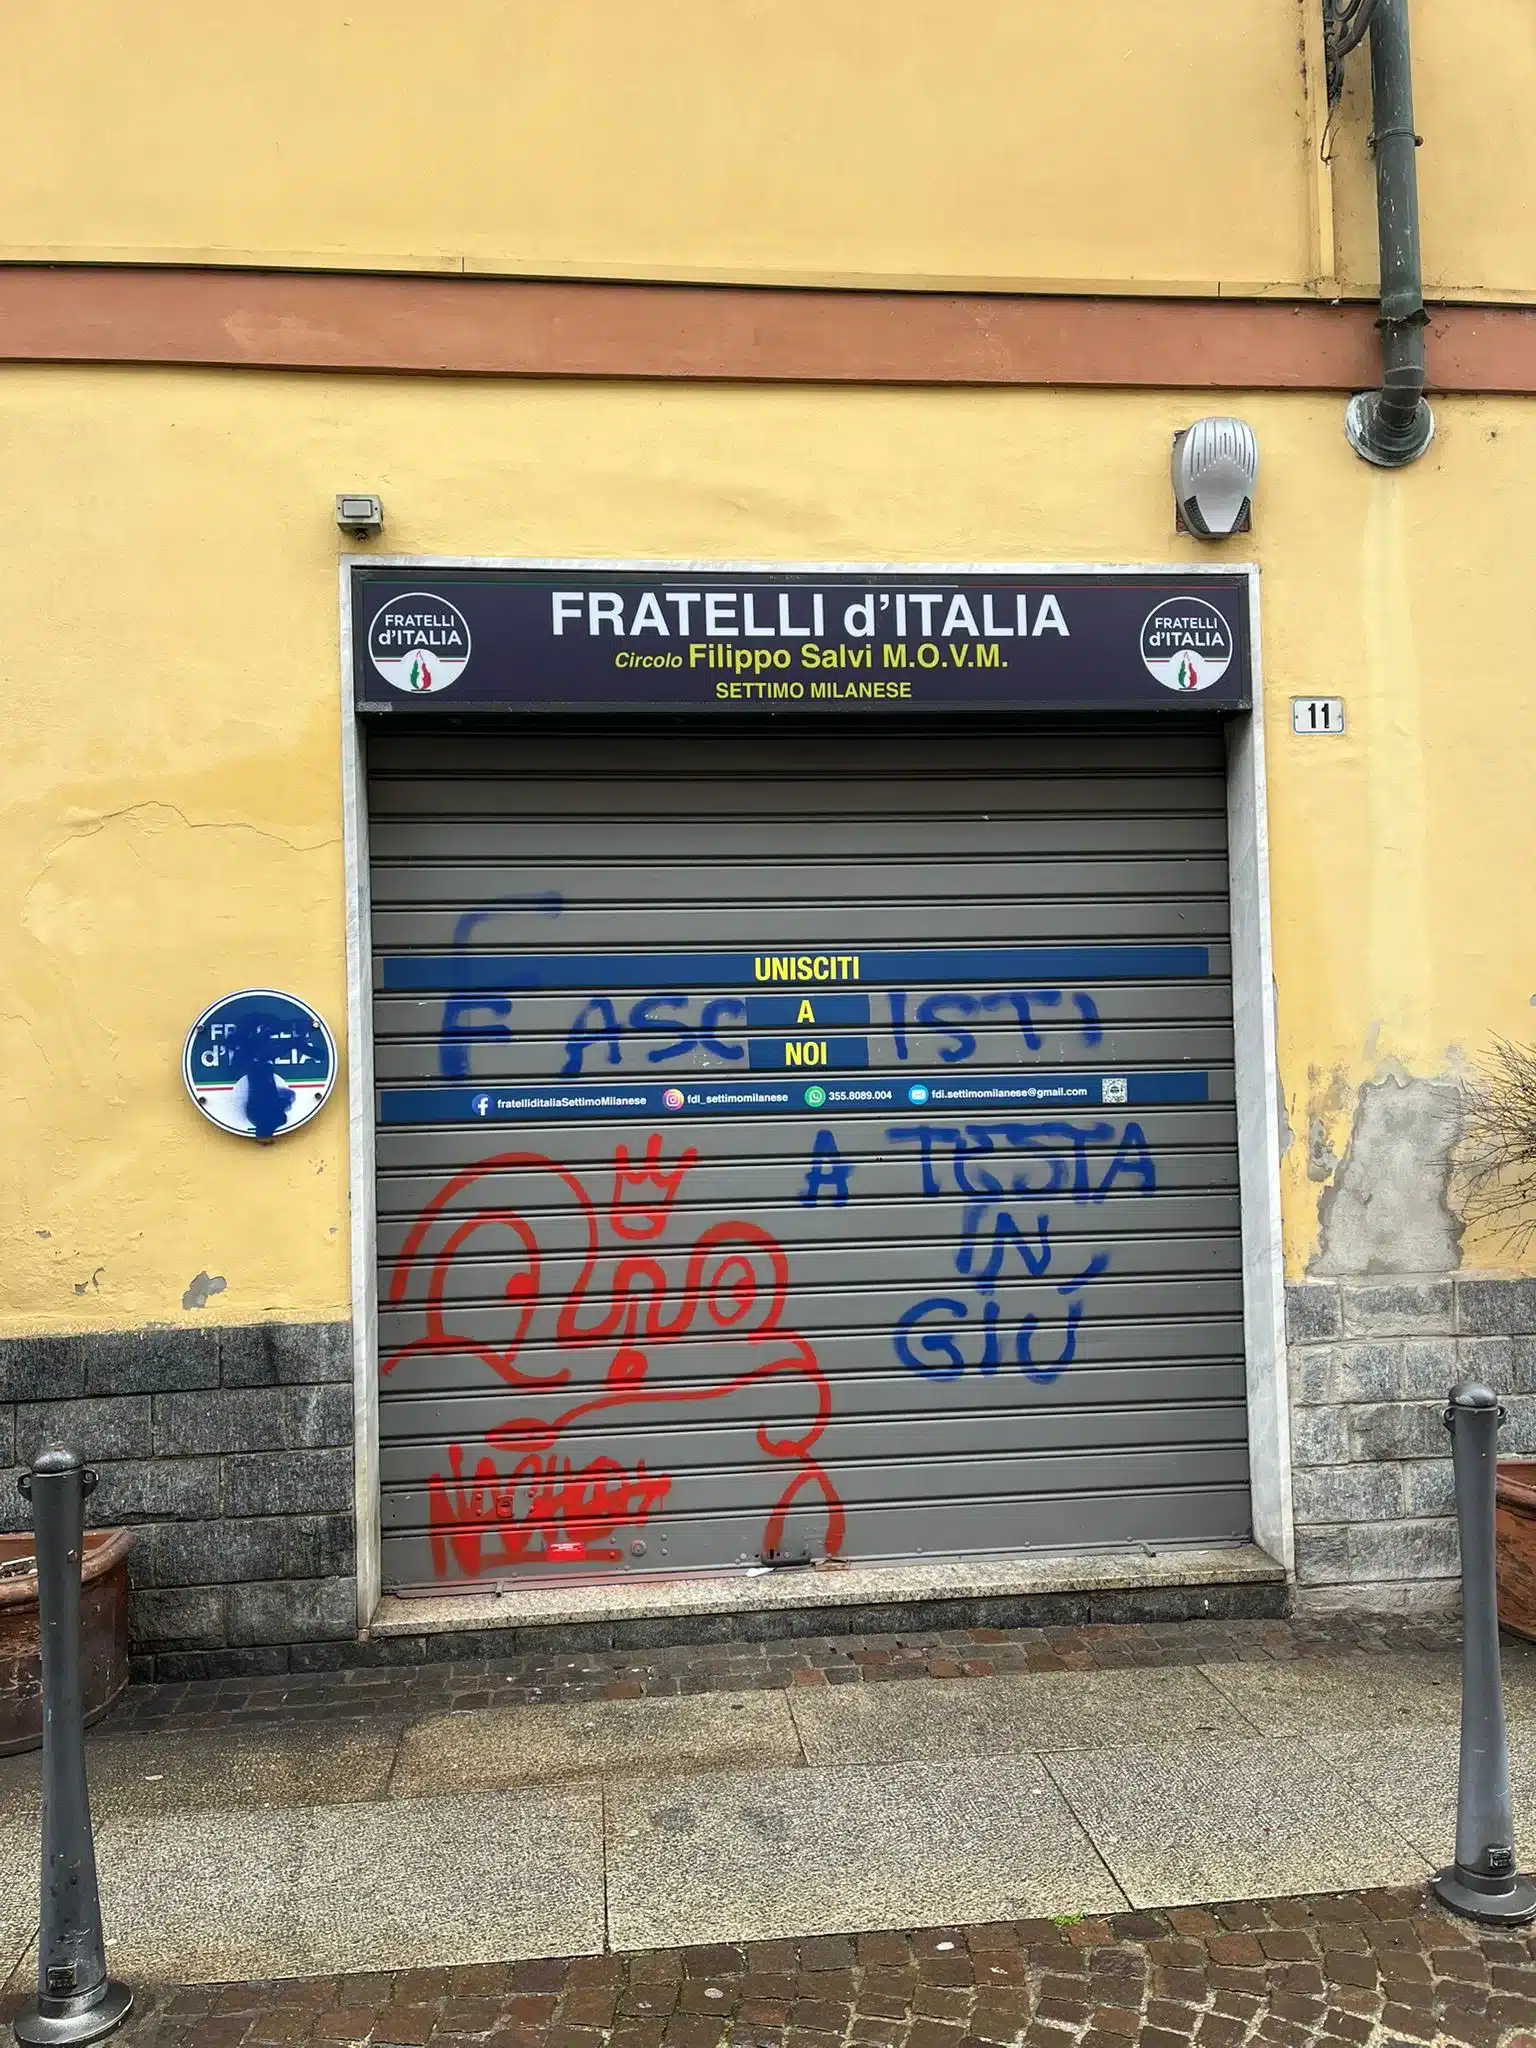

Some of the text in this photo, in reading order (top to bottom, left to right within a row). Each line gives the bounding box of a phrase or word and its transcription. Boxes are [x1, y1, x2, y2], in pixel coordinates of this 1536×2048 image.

[384, 614, 455, 627] FRATELLI
[551, 591, 1070, 637] FRATELLI d'ITALIA
[1154, 617, 1218, 629] FRATELLI
[378, 629, 463, 646] d'ITALIA
[1149, 631, 1225, 647] d'ITALIA
[614, 643, 1009, 674] Circolo Filippo Salvi M.O.V.M.
[715, 682, 912, 699] SETTIMO MILANESE
[1307, 702, 1330, 729] 11
[754, 956, 860, 981] UNISCITI
[796, 999, 816, 1024] A
[784, 1041, 828, 1066] NOI
[828, 1090, 893, 1101] 355.8089.004
[931, 1087, 1089, 1101] fdi.settimomilanese@gmail.com
[799, 1129, 855, 1208] A
